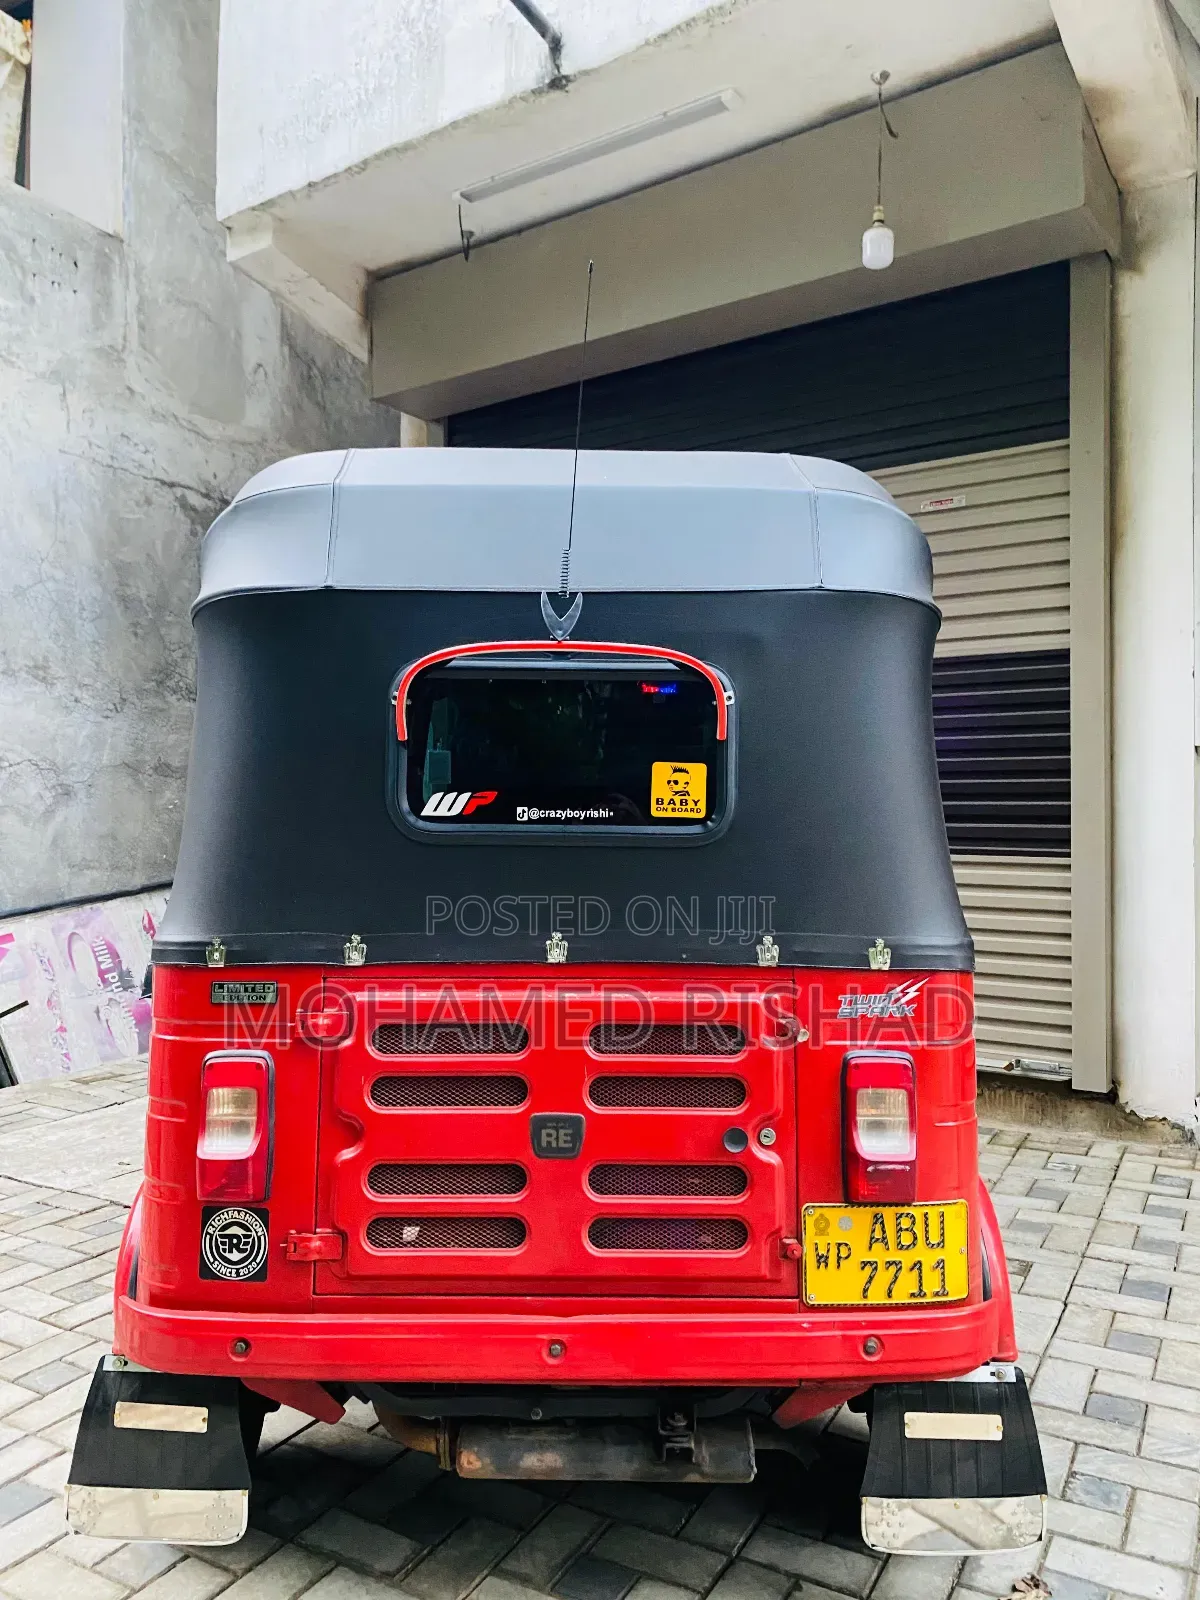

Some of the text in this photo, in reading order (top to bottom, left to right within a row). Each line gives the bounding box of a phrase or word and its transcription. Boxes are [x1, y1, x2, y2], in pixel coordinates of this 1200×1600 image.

[420, 791, 498, 817] WP
[655, 797, 701, 807] BABY
[91, 936, 114, 970] Milk
[214, 984, 275, 993] LIMITED
[222, 994, 267, 1002] EDITION
[838, 993, 894, 1006] TWIN
[837, 1003, 918, 1019] SPARK
[541, 1128, 573, 1148] RE
[207, 1210, 265, 1237] RICHFASHION
[868, 1210, 945, 1252] ABU
[813, 1241, 852, 1270] WP
[212, 1260, 237, 1277] SINCE
[859, 1258, 949, 1299] 7711
